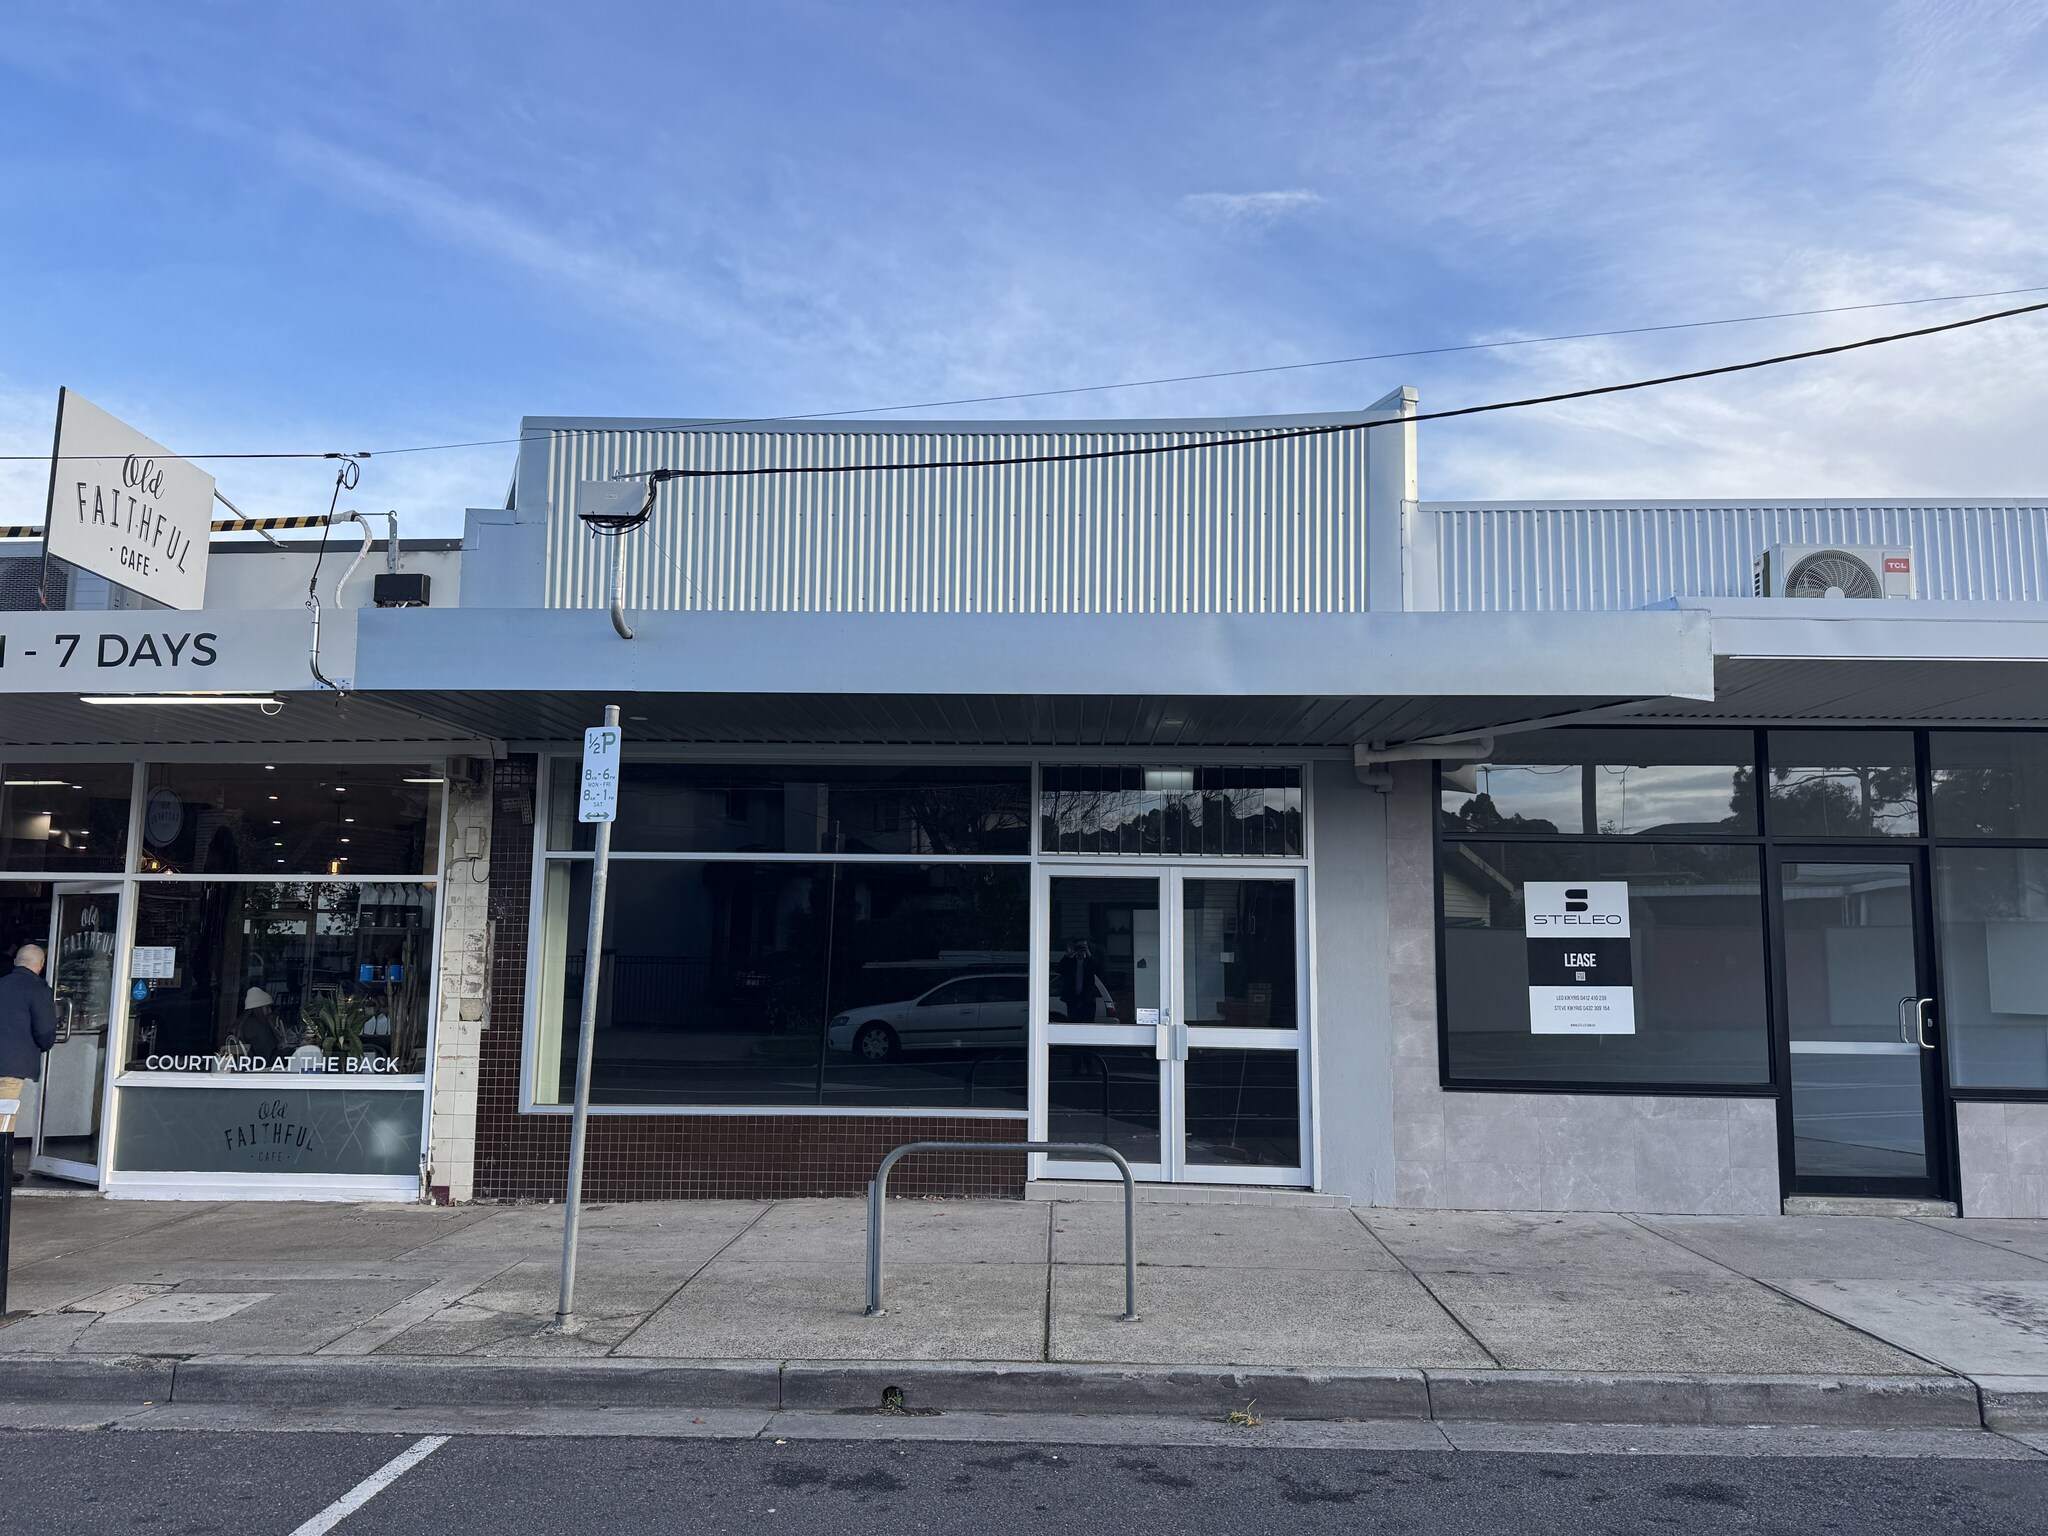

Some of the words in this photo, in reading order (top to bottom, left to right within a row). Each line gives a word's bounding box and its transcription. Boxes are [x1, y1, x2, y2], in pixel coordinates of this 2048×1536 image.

[122, 453, 166, 500] Old
[76, 482, 190, 574] FAITHFUL
[120, 546, 150, 576] CAFE
[55, 634, 80, 668] 7
[98, 633, 217, 668] DAYS
[1533, 914, 1622, 925] STELEO
[1564, 953, 1597, 967] LEASE
[145, 1054, 266, 1071] COURTYARD
[270, 1056, 295, 1072] AT
[301, 1057, 339, 1072] THE
[346, 1057, 399, 1073] BACK
[258, 1100, 288, 1120] Old
[258, 1152, 282, 1162] CAFE
